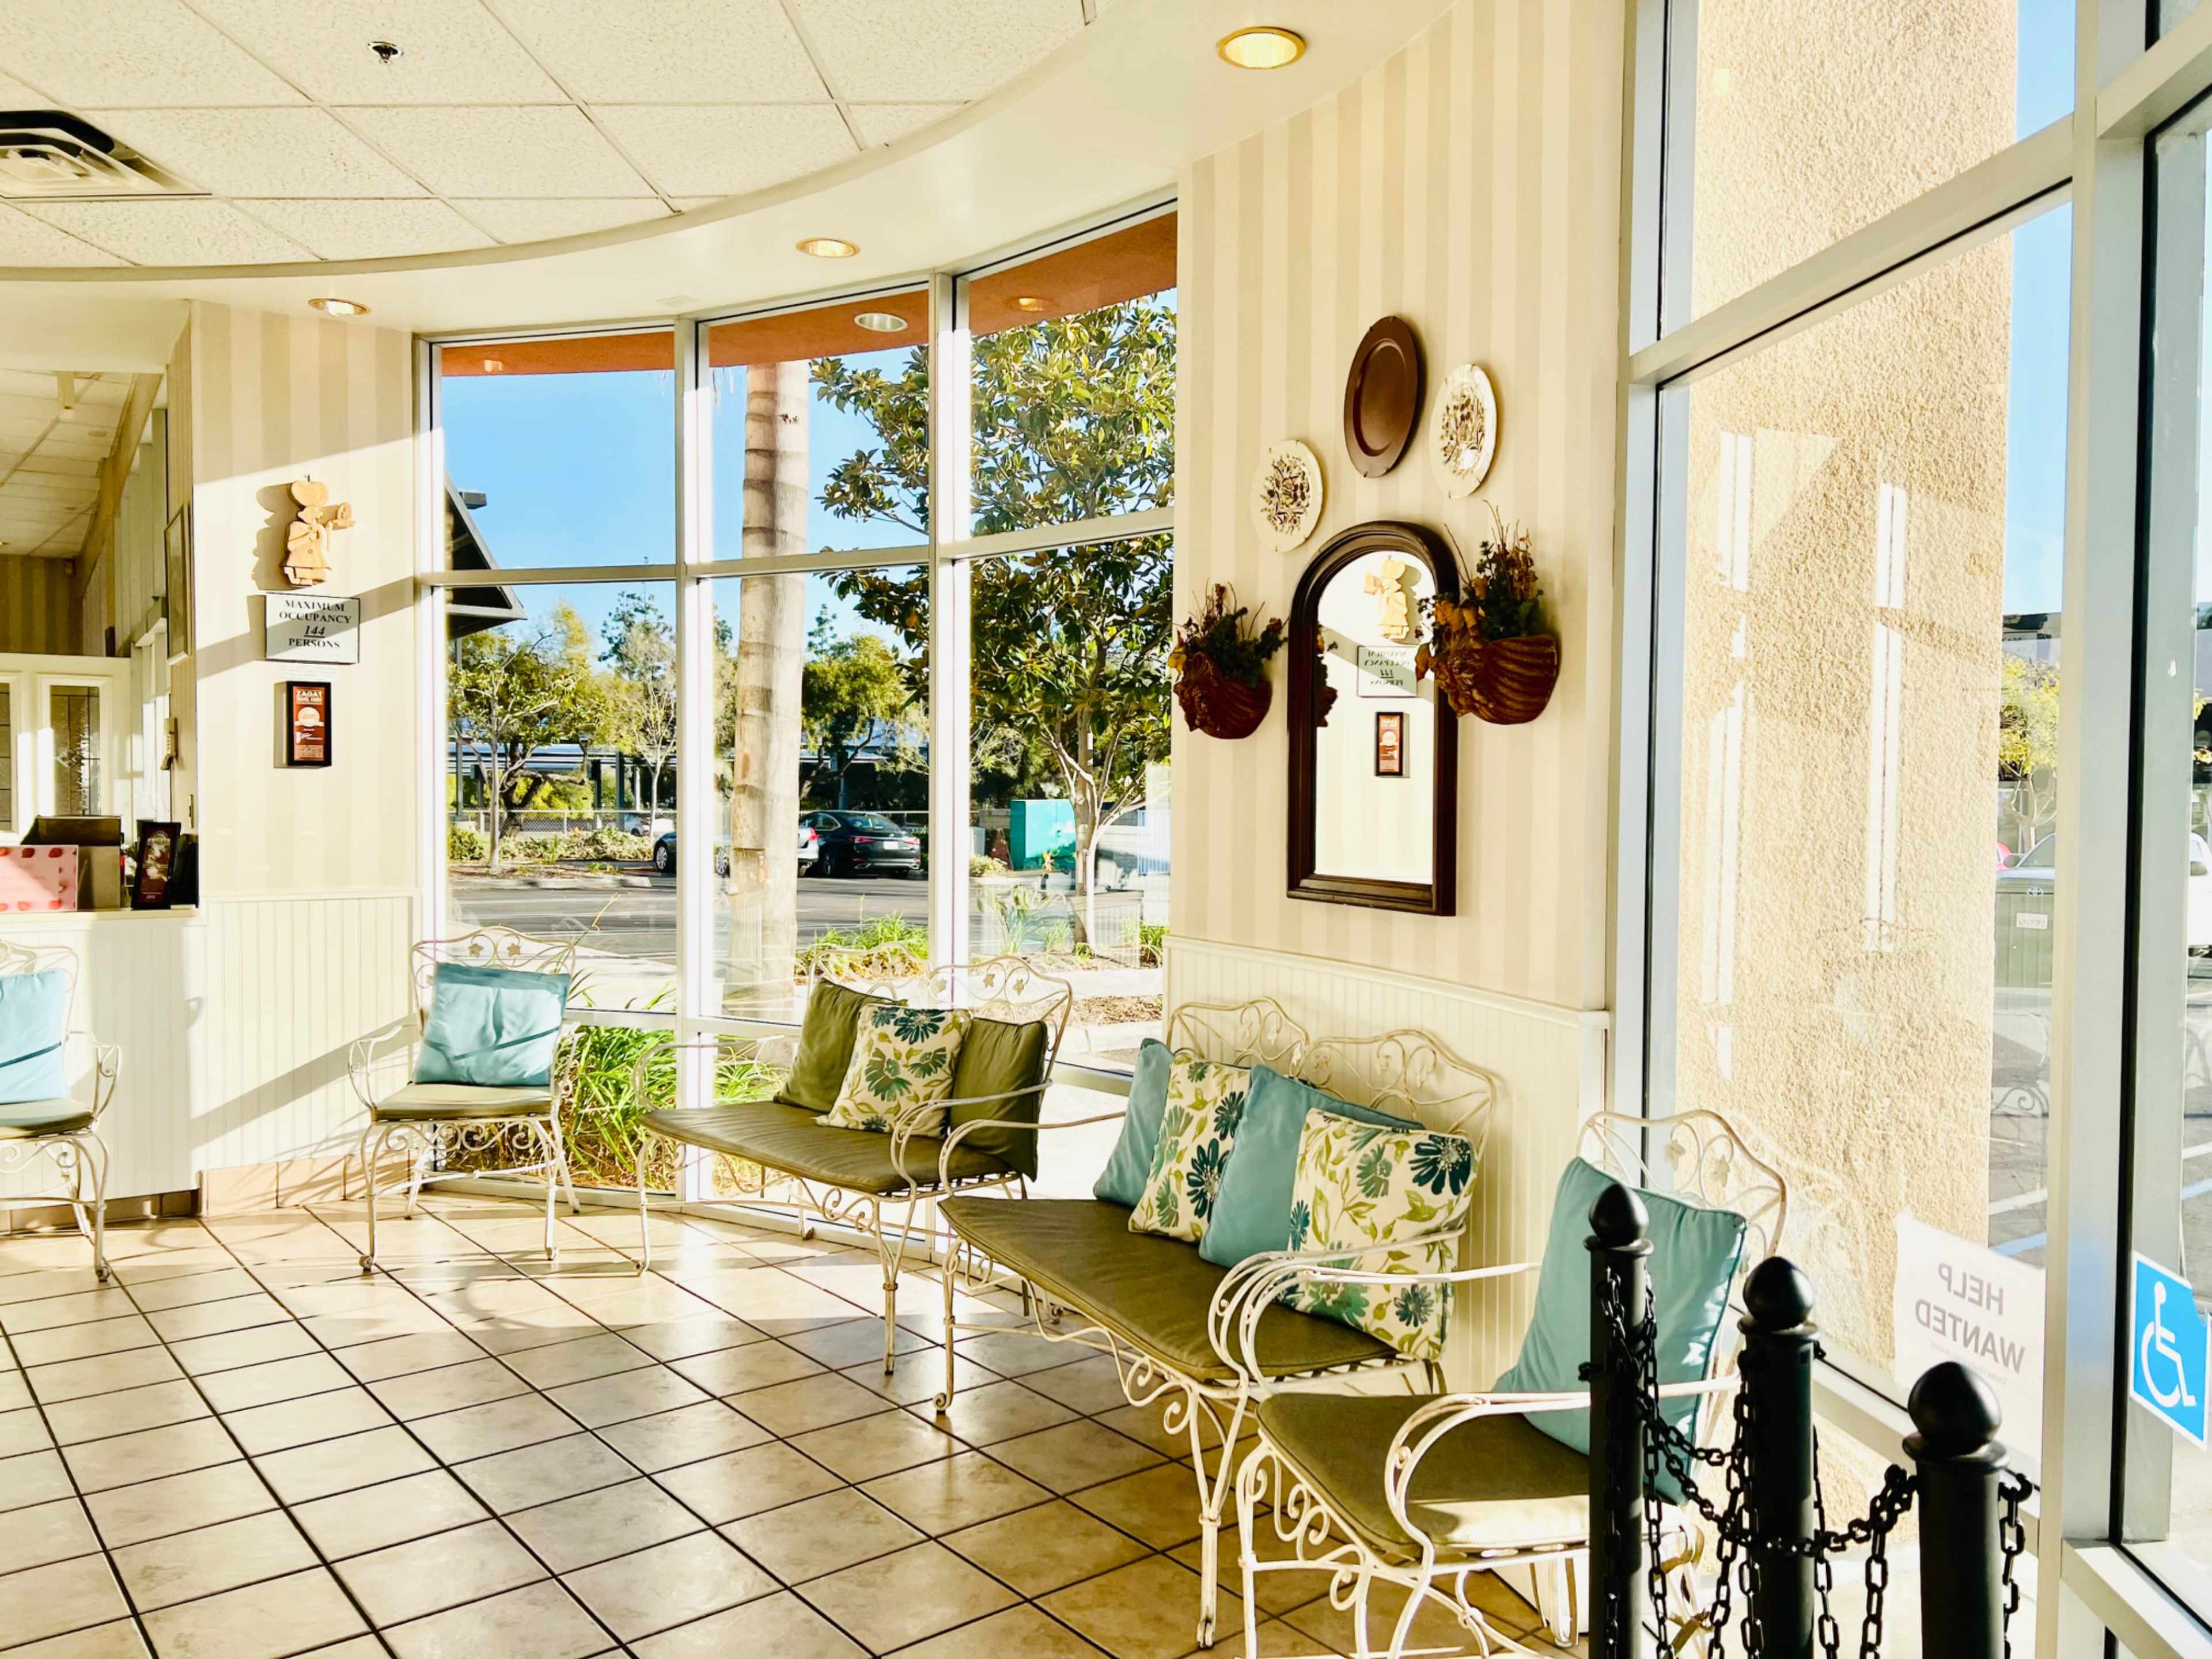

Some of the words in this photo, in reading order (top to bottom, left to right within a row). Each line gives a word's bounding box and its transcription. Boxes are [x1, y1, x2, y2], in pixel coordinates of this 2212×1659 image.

[286, 600, 345, 611] MAXIMUM
[279, 611, 351, 623] OCCUPANCY
[304, 626, 325, 635] 144
[289, 638, 340, 648] PERSONS
